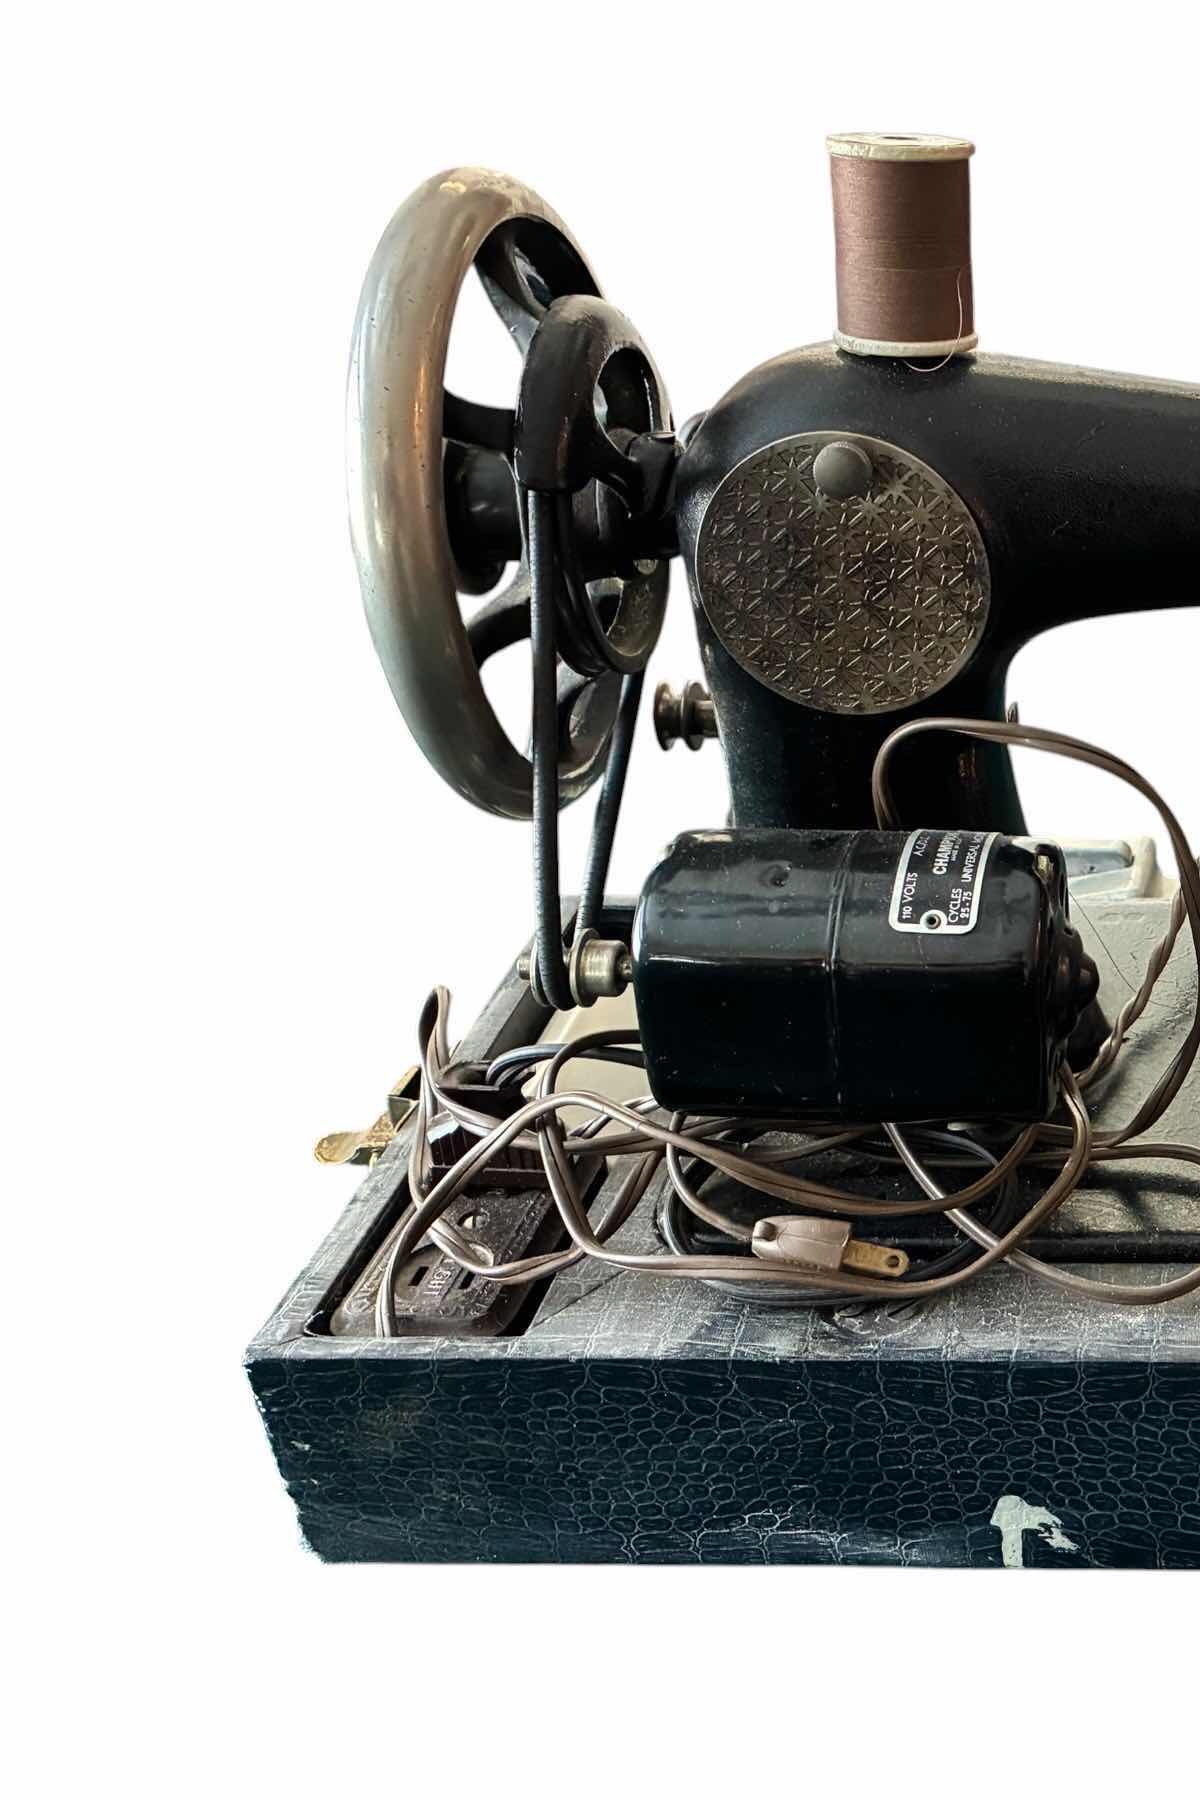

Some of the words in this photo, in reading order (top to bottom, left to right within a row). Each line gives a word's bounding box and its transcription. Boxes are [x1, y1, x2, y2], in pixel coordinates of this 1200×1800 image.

[961, 844, 981, 883] UNIVERSAL
[902, 872, 918, 904] VOLTS
[902, 905, 913, 919] 110
[948, 888, 963, 923] CYCLES
